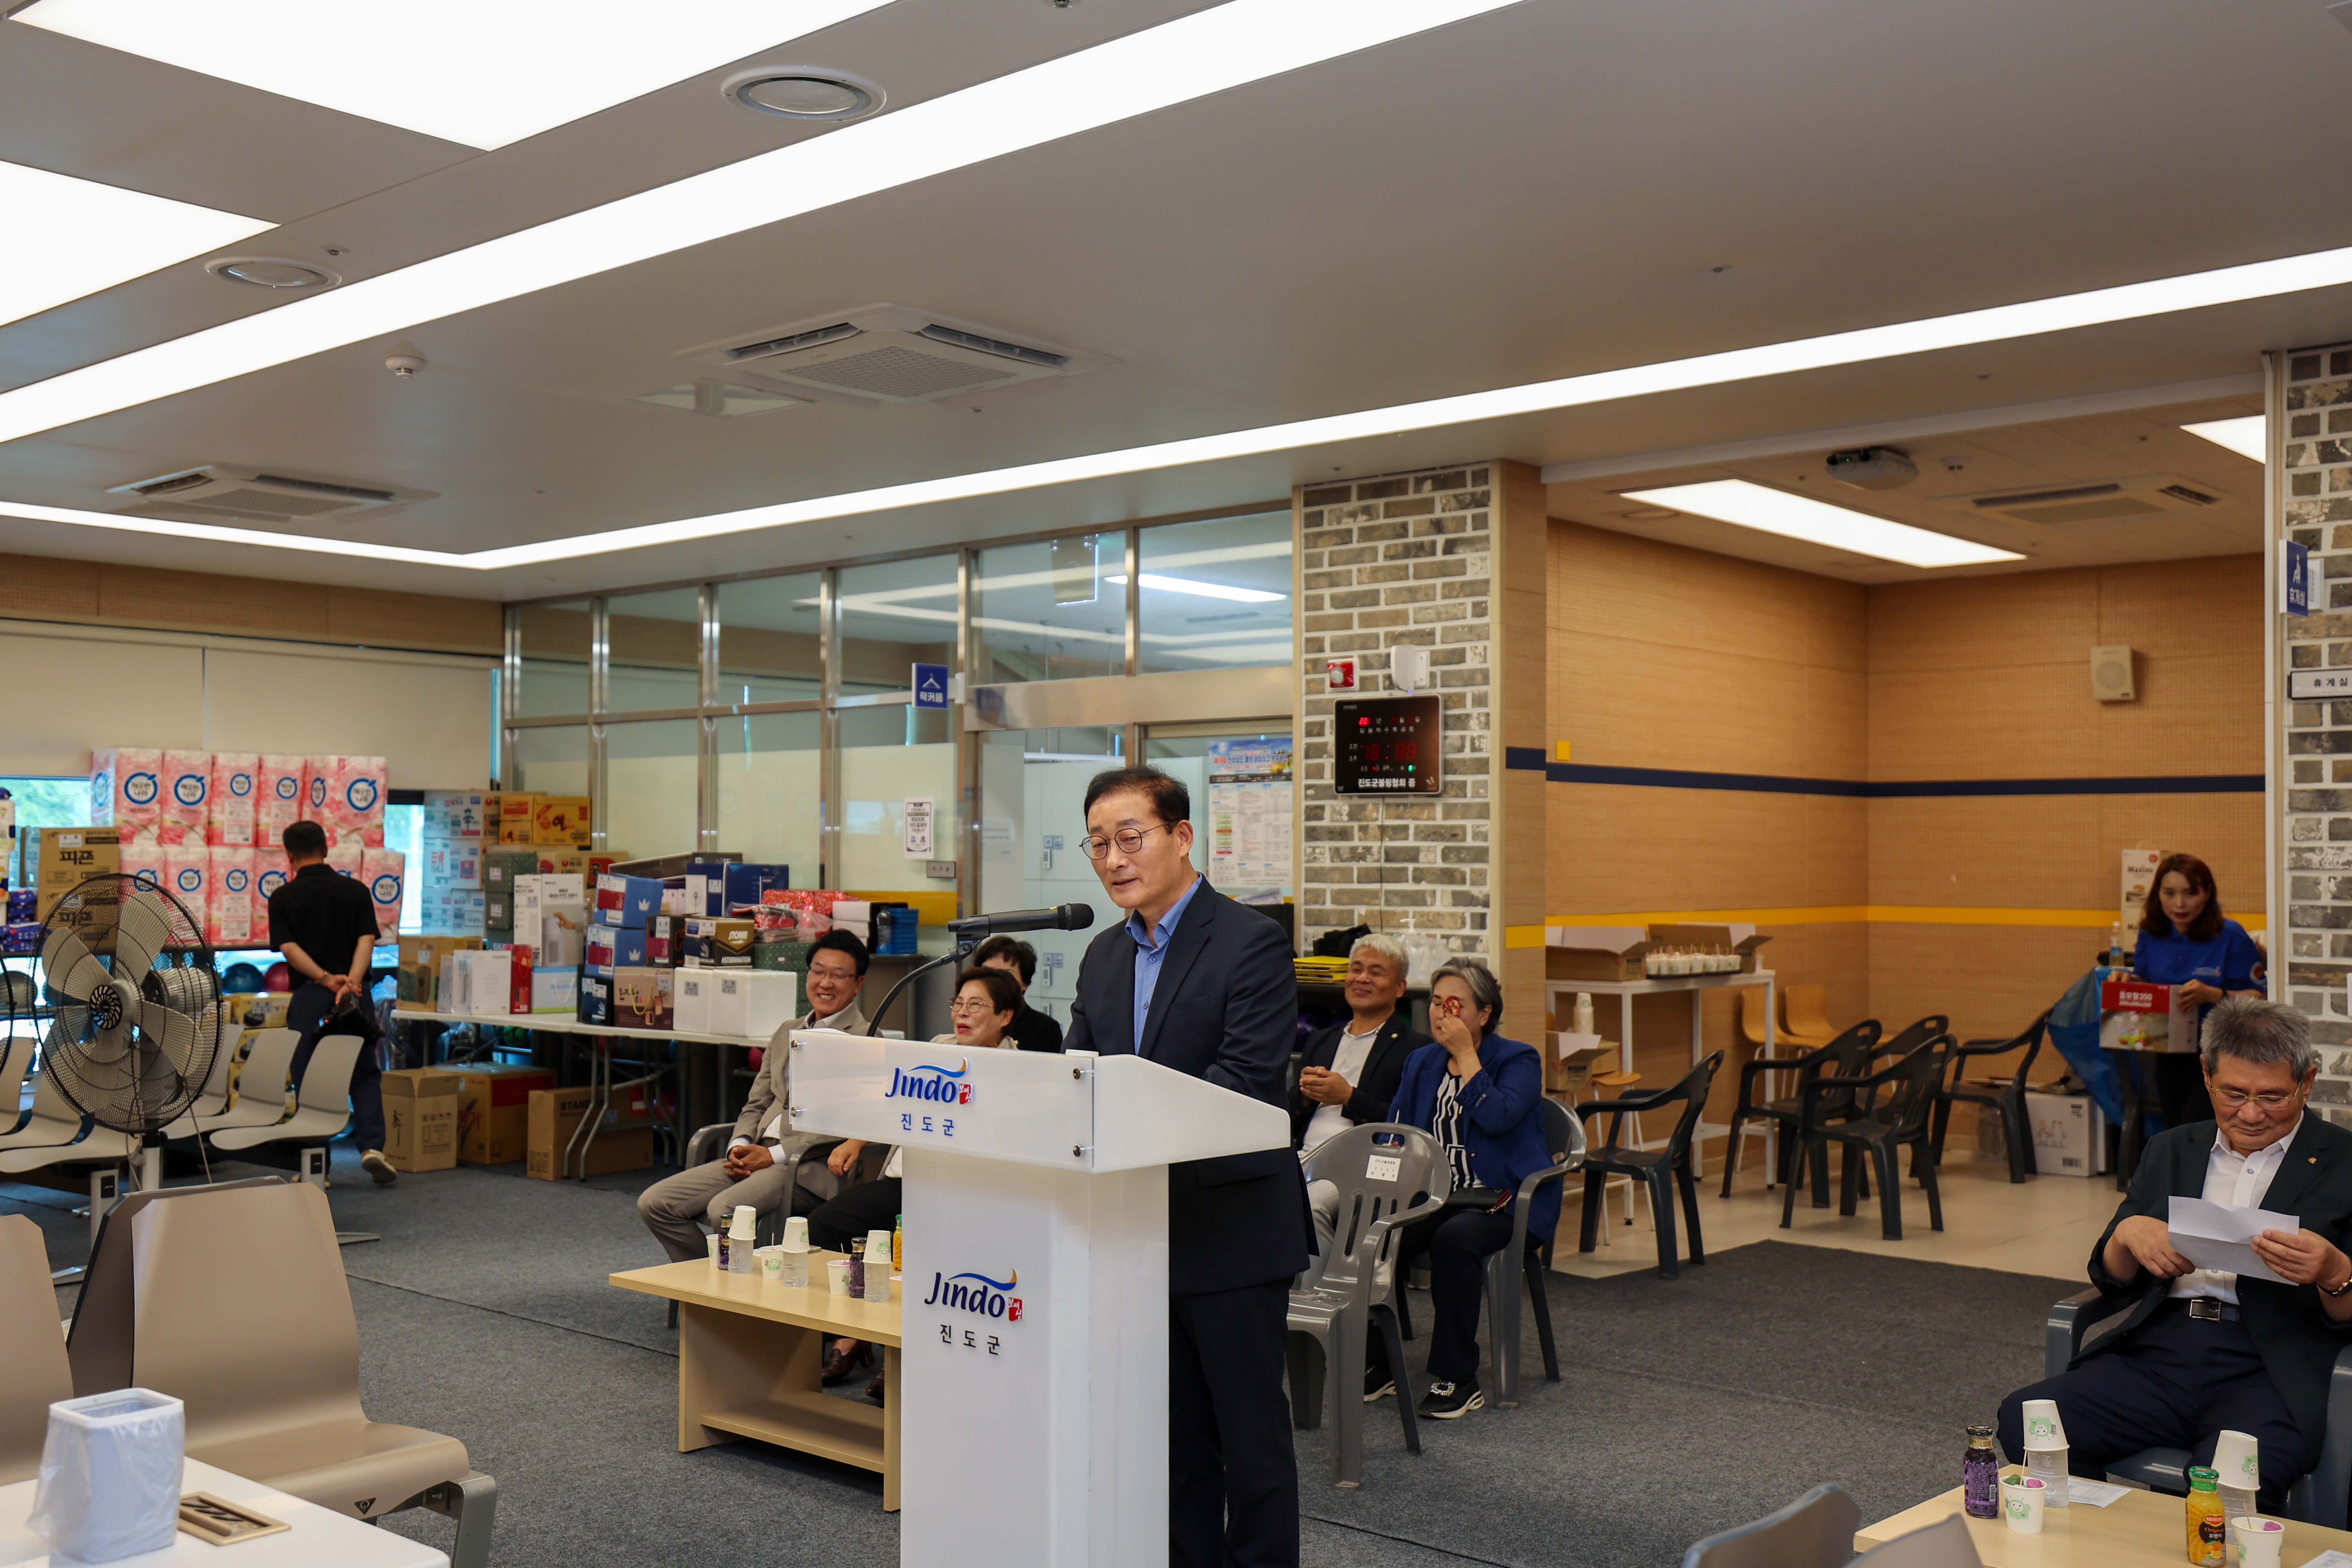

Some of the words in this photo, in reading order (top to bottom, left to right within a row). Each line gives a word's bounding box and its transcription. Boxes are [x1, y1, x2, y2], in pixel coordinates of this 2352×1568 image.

[2289, 587, 2305, 607] 휴게실
[2313, 677, 2348, 688] 휴게실
[919, 691, 943, 702] 락커룸
[1358, 778, 1406, 788] 진도군볼링협회
[1408, 778, 1416, 787] 증
[60, 850, 94, 865] 피죤
[728, 931, 748, 940] STORM
[885, 1067, 957, 1103] Jindo
[901, 1113, 955, 1137] 진도군
[924, 1272, 1006, 1319] Jindo
[940, 1324, 1000, 1355] 진도군
